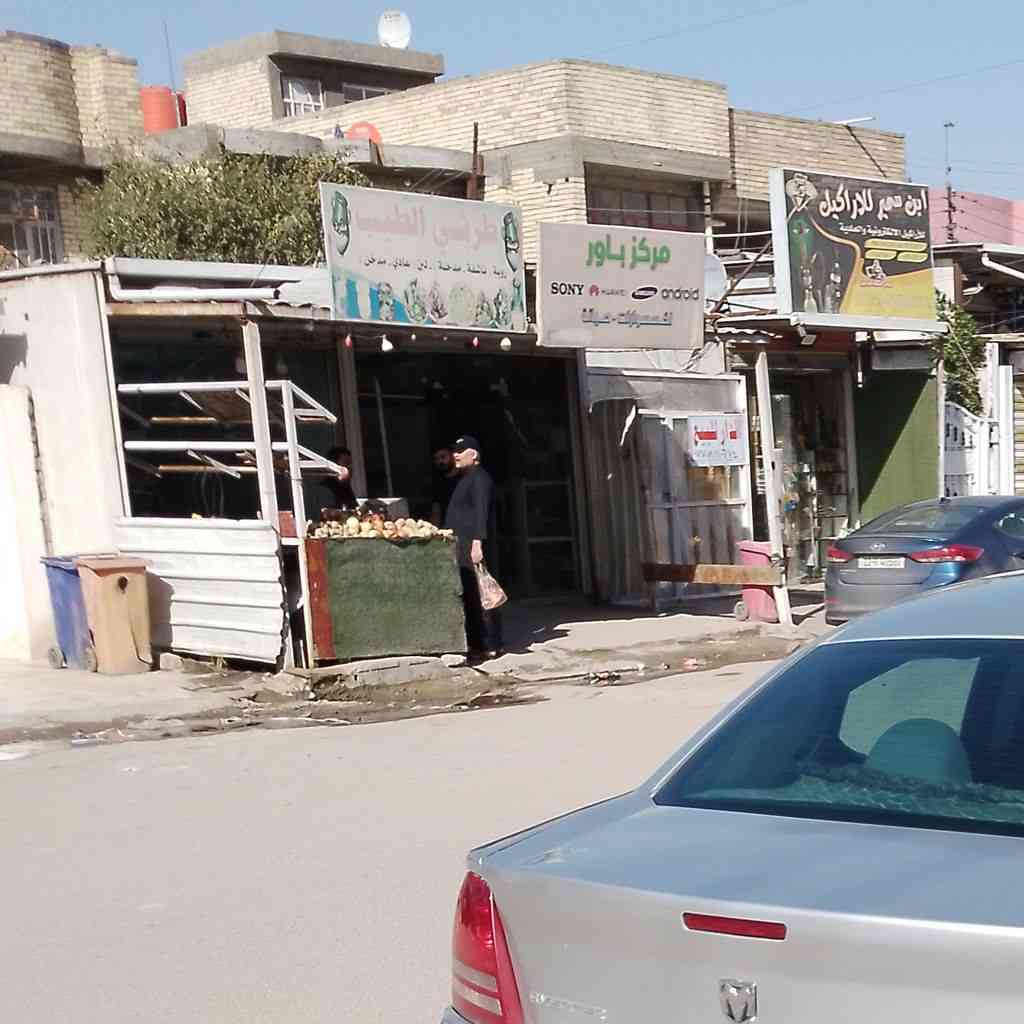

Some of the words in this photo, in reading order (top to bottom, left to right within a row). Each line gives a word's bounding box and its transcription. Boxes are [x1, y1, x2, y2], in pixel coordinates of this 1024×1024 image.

[904, 188, 928, 217] ابن
[585, 233, 625, 269] باور
[629, 234, 671, 271] مركز
[550, 281, 585, 297] SONY
[661, 287, 700, 300] android
